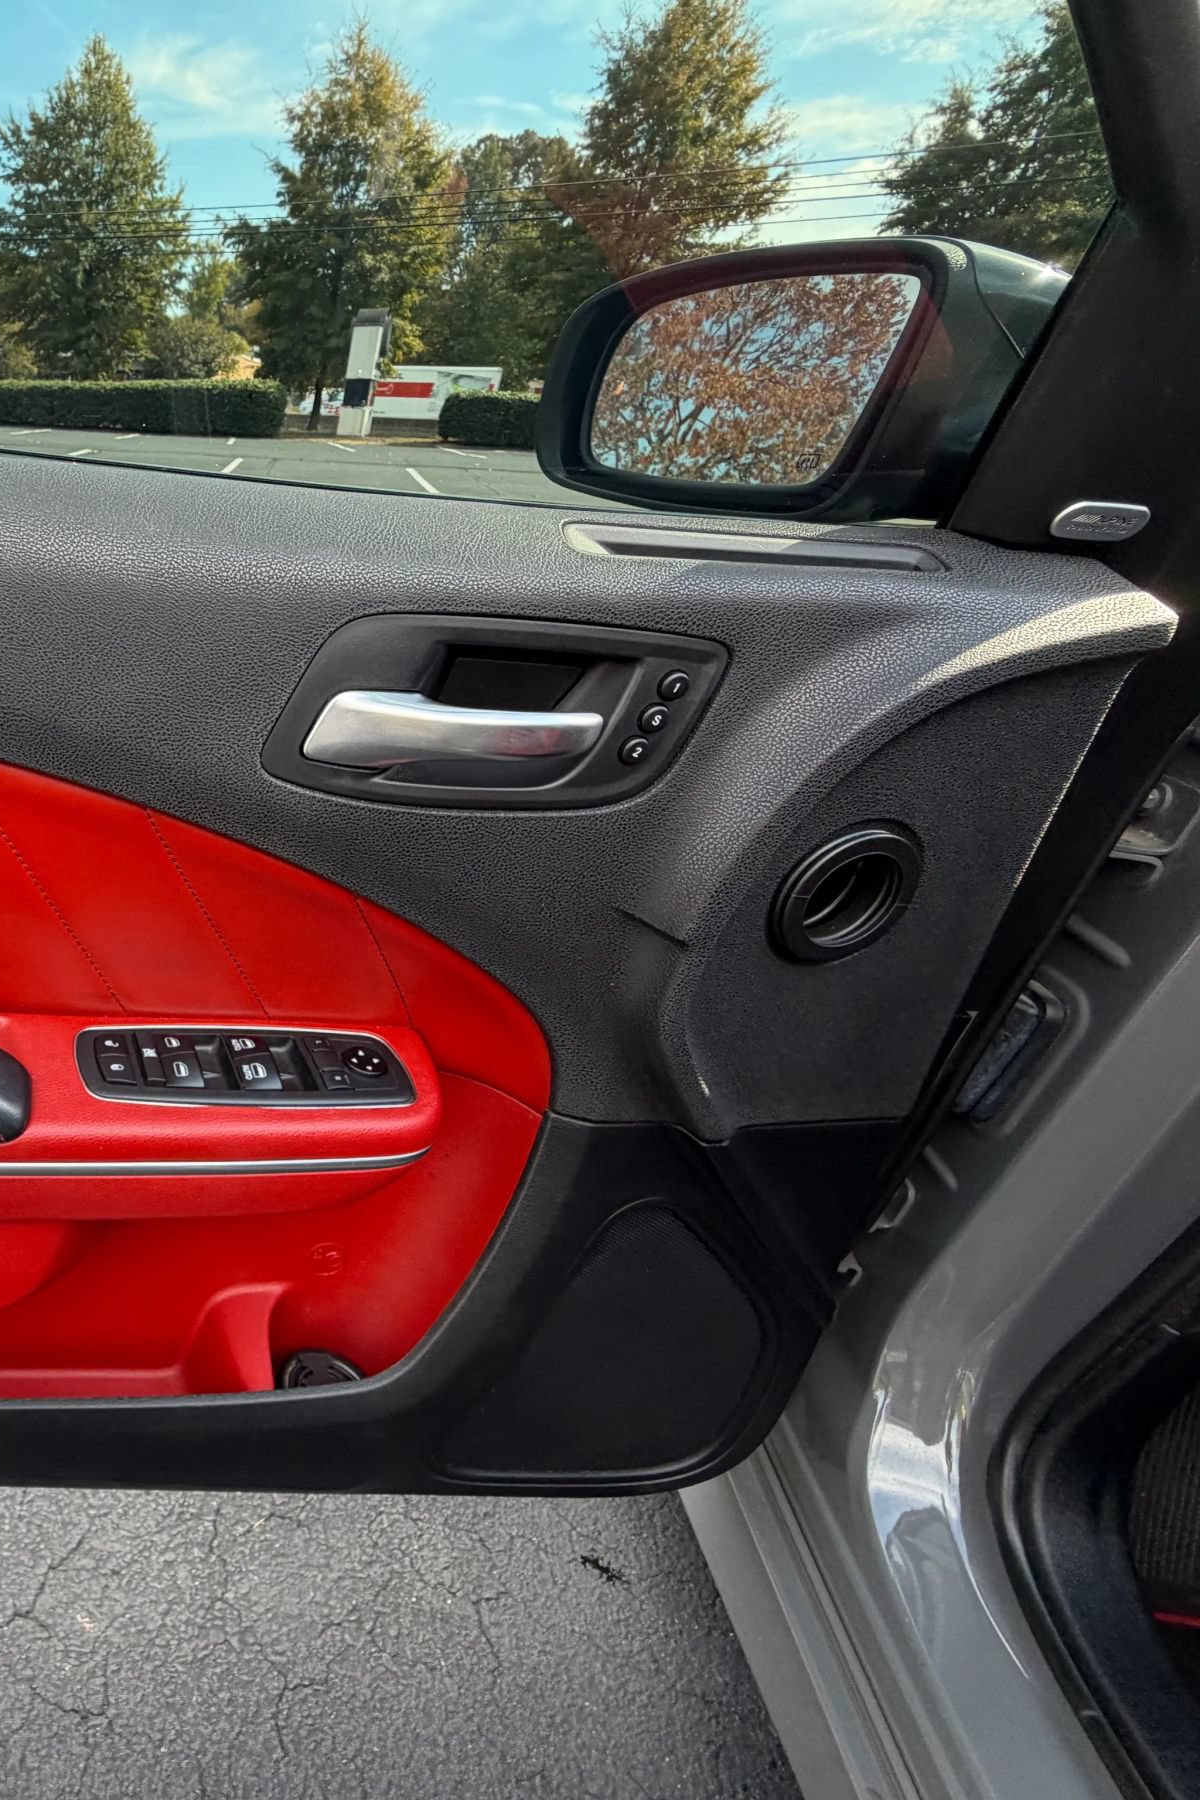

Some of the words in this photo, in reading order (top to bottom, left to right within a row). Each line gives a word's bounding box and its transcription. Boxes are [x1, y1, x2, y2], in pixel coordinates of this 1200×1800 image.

[673, 683, 680, 693] 1
[651, 715, 662, 726] S
[632, 747, 642, 758] 2
[241, 1064, 253, 1081] AUTO
